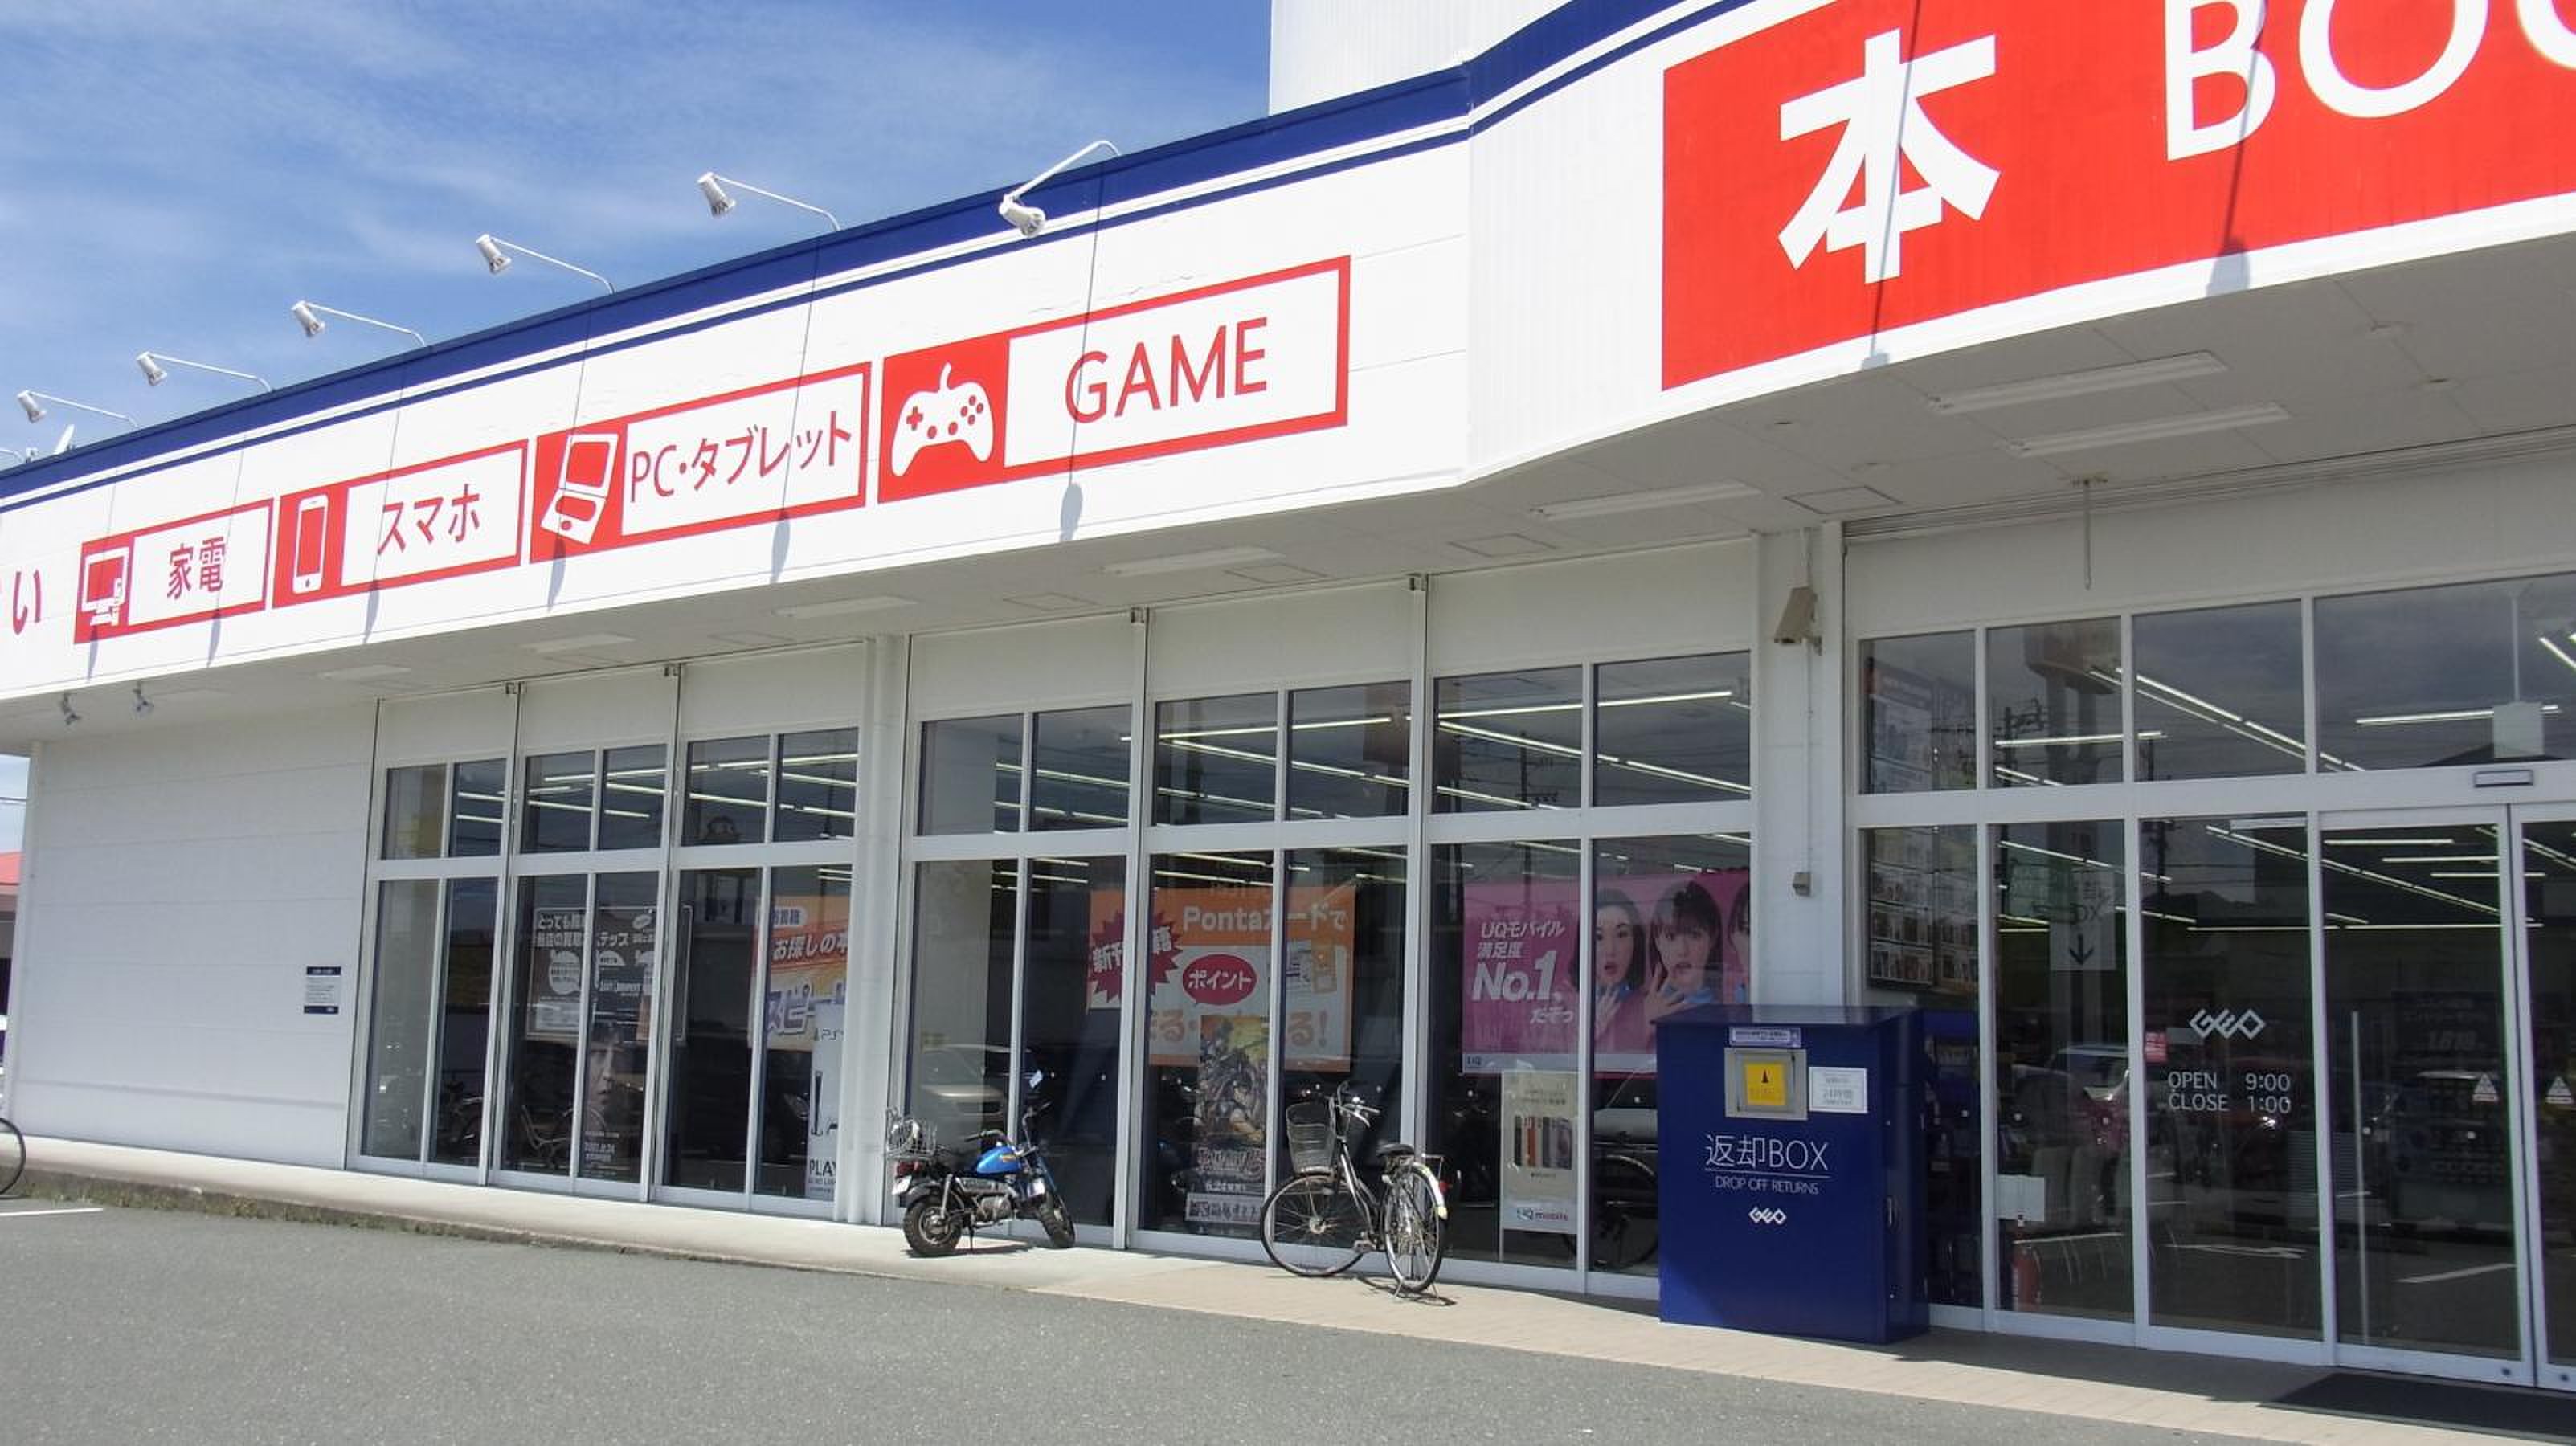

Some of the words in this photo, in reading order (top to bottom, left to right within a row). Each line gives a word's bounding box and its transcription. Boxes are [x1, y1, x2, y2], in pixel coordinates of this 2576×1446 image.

[2165, 0, 2576, 161] BO
[1777, 27, 2001, 284] 本
[1065, 317, 1269, 424] GAME
[378, 484, 480, 556] スマホ
[166, 537, 227, 600] 家電
[12, 569, 42, 635] い
[1481, 921, 1565, 939] UQモバイル
[1478, 941, 1523, 958] 満足度
[1188, 970, 1252, 991] ポイント
[2188, 1008, 2266, 1040] GEO
[2168, 1072, 2218, 1089] OPEN
[2245, 1073, 2290, 1092] 9:00
[2168, 1093, 2229, 1112] CLOSE
[2247, 1096, 2291, 1113] 1:00
[1705, 1134, 1829, 1170] 返却BOX
[1715, 1175, 1747, 1190] DROP
[1748, 1178, 1768, 1191] OFF
[1772, 1179, 1820, 1195] RETURNS
[1748, 1206, 1787, 1225] GEO
